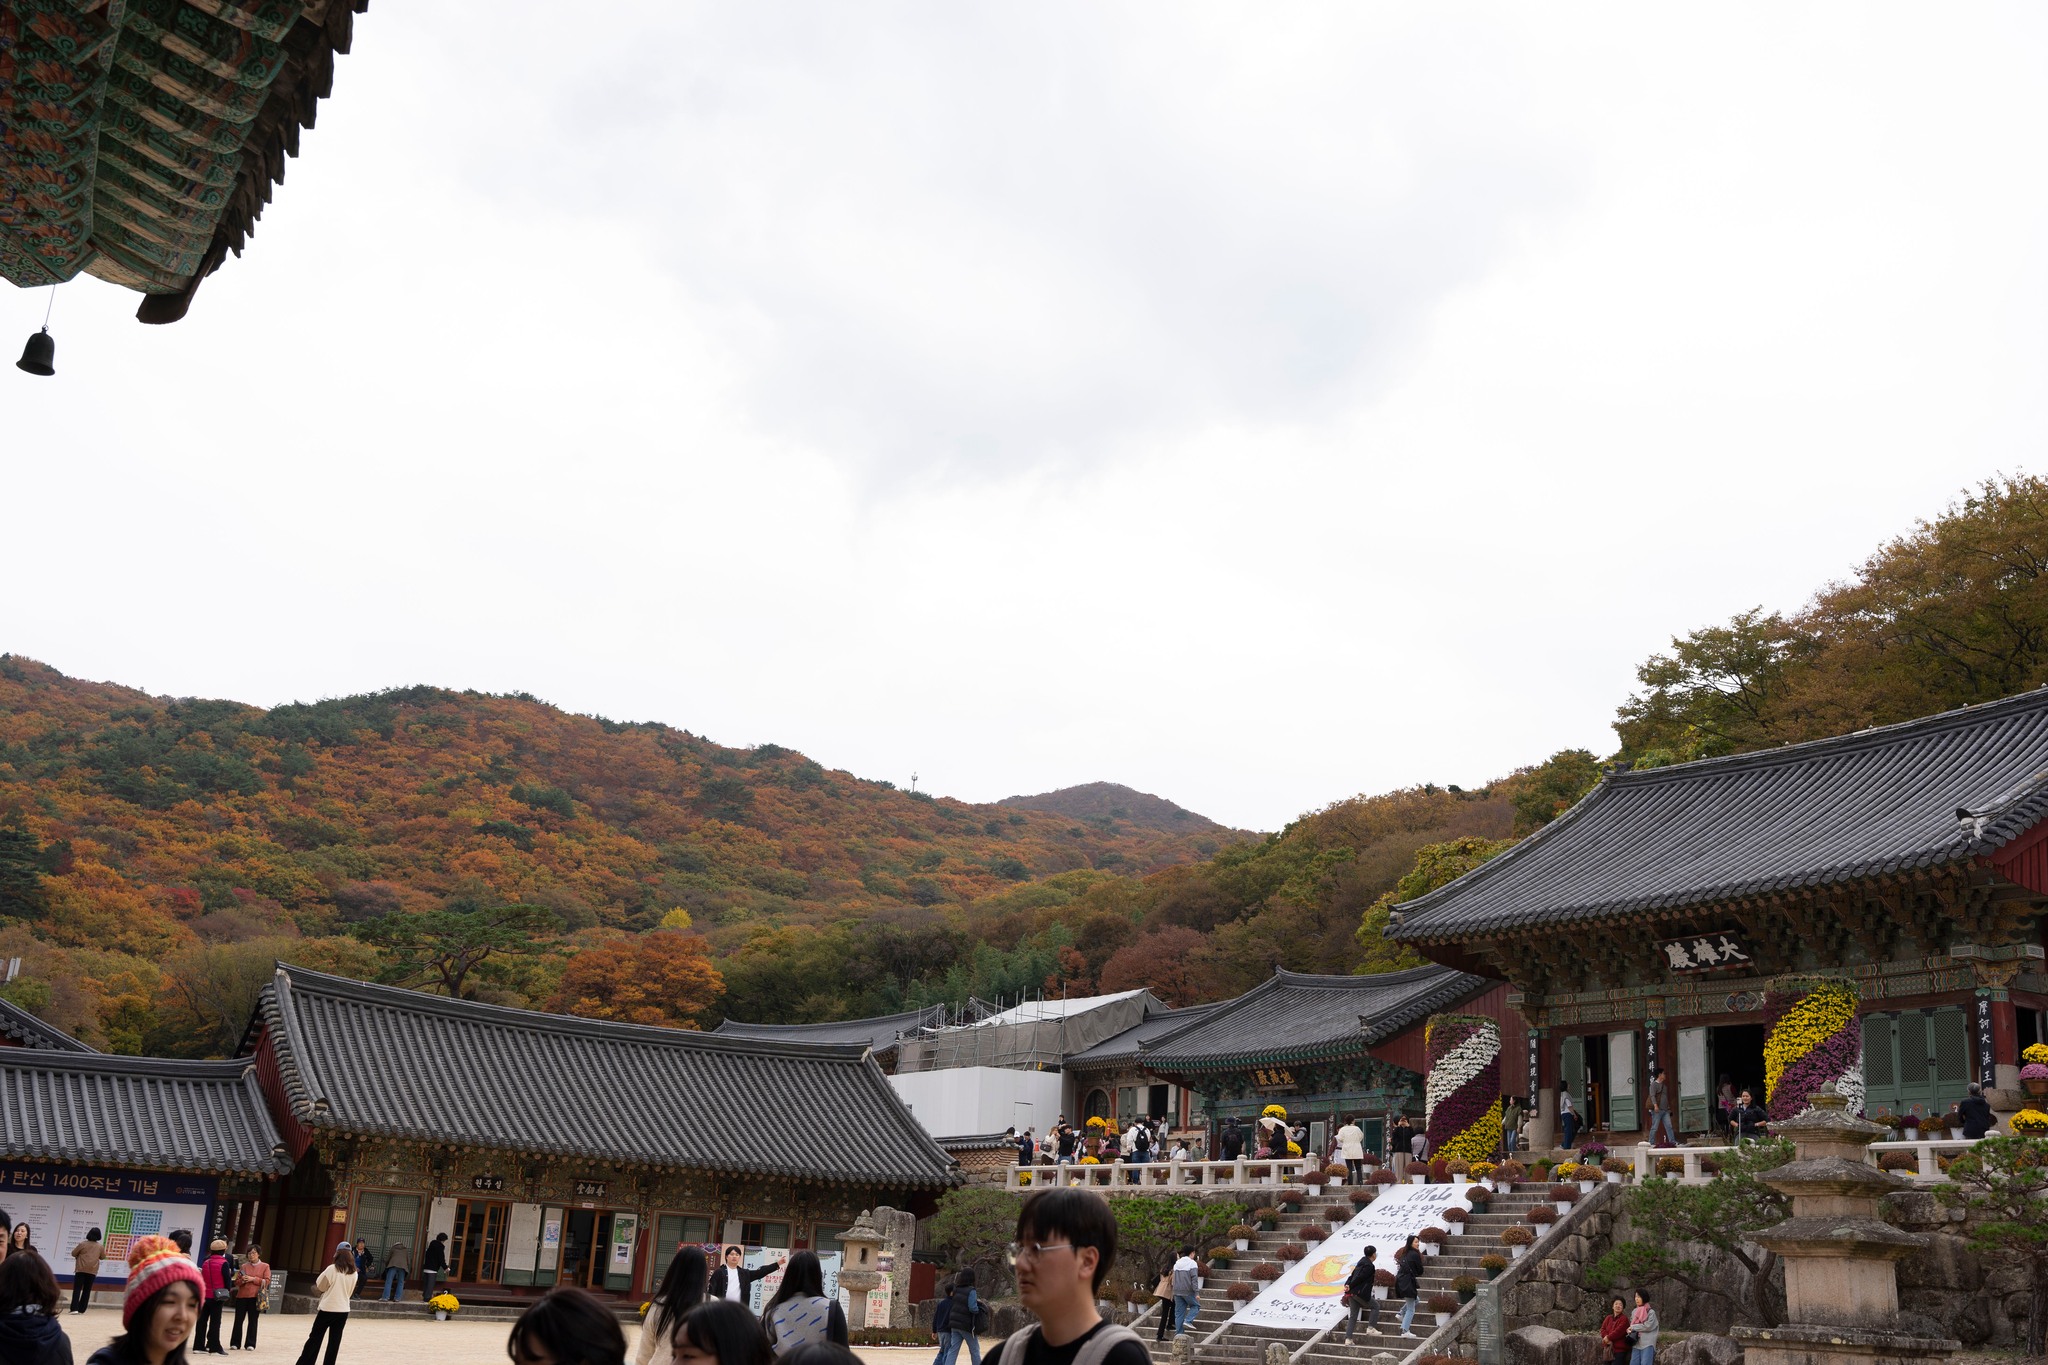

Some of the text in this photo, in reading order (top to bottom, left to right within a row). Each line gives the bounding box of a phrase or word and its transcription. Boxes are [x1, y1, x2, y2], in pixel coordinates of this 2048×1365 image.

[12, 1171, 46, 1187] 탄신
[53, 1173, 121, 1192] 1400주년
[128, 1180, 159, 1195] 기념
